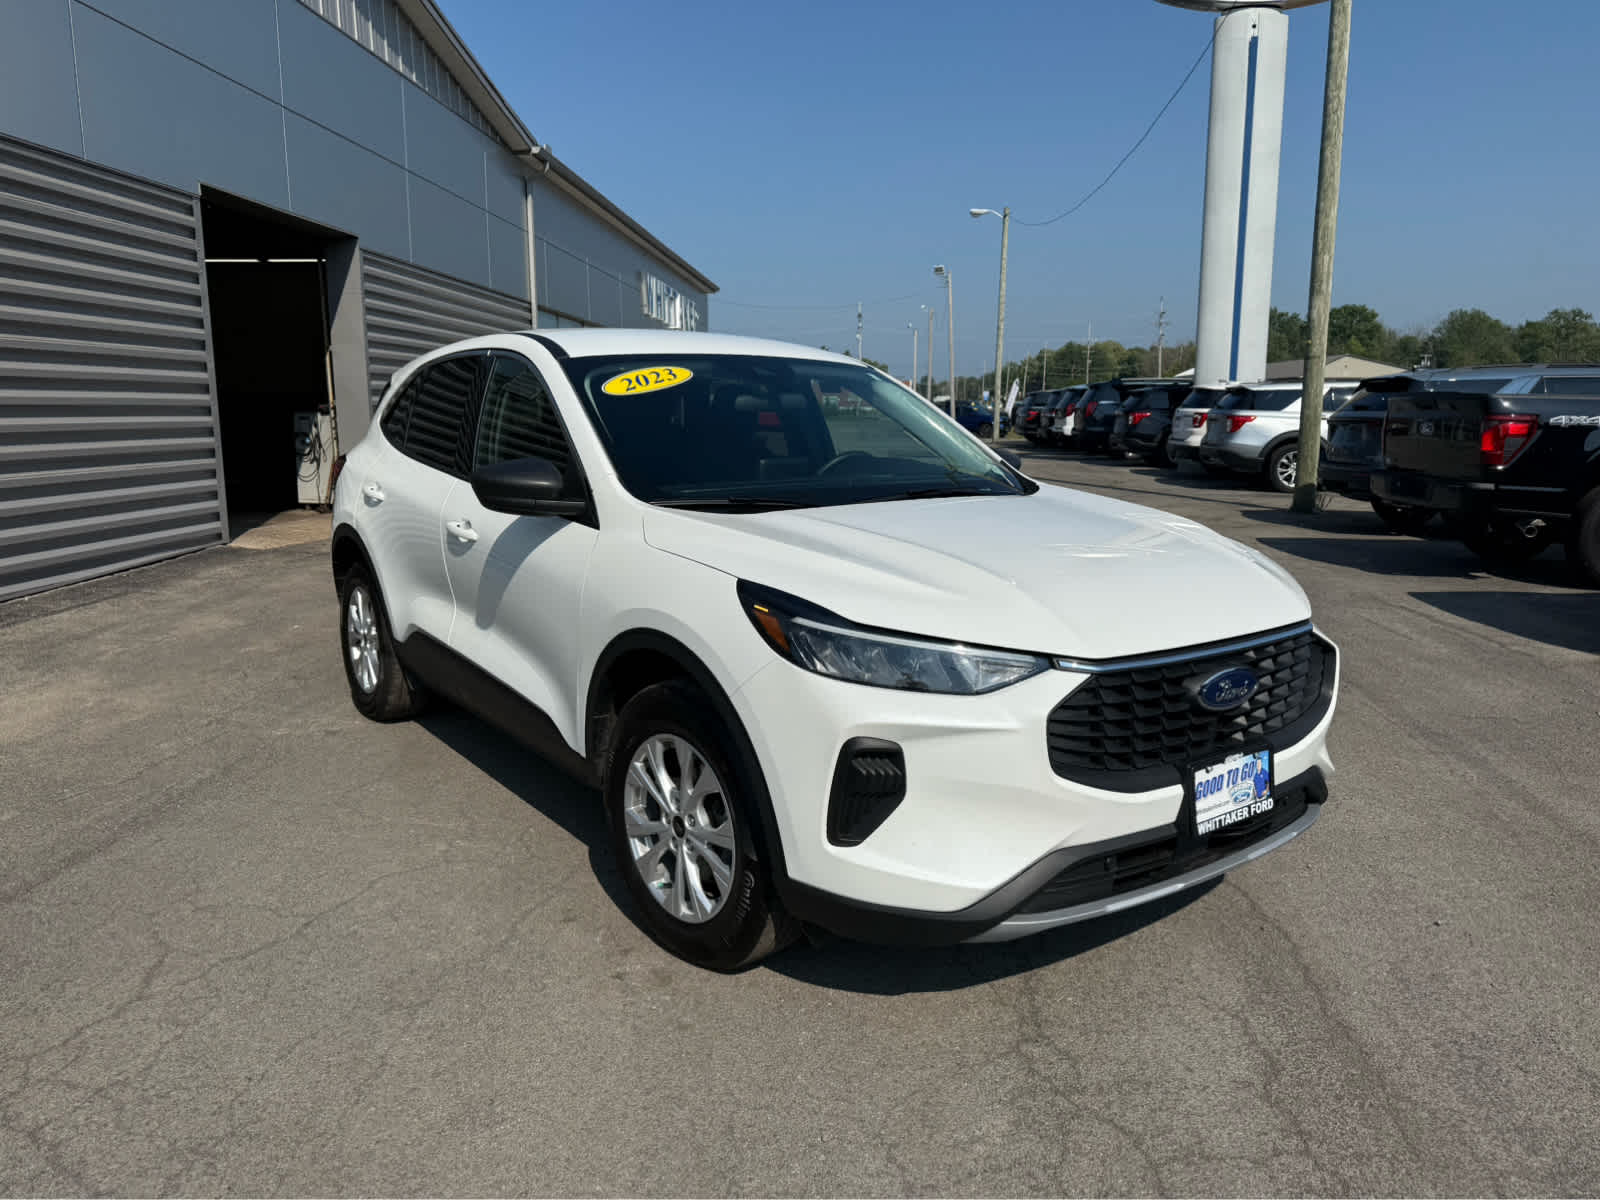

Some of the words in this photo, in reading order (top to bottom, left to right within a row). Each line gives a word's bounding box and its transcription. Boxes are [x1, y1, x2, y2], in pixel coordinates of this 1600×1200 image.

[620, 368, 677, 392] 2023
[1196, 774, 1224, 800] GOOD
[1227, 767, 1240, 788] TO
[1198, 808, 1249, 836] WHITTAKER
[1250, 798, 1273, 816] FORD
